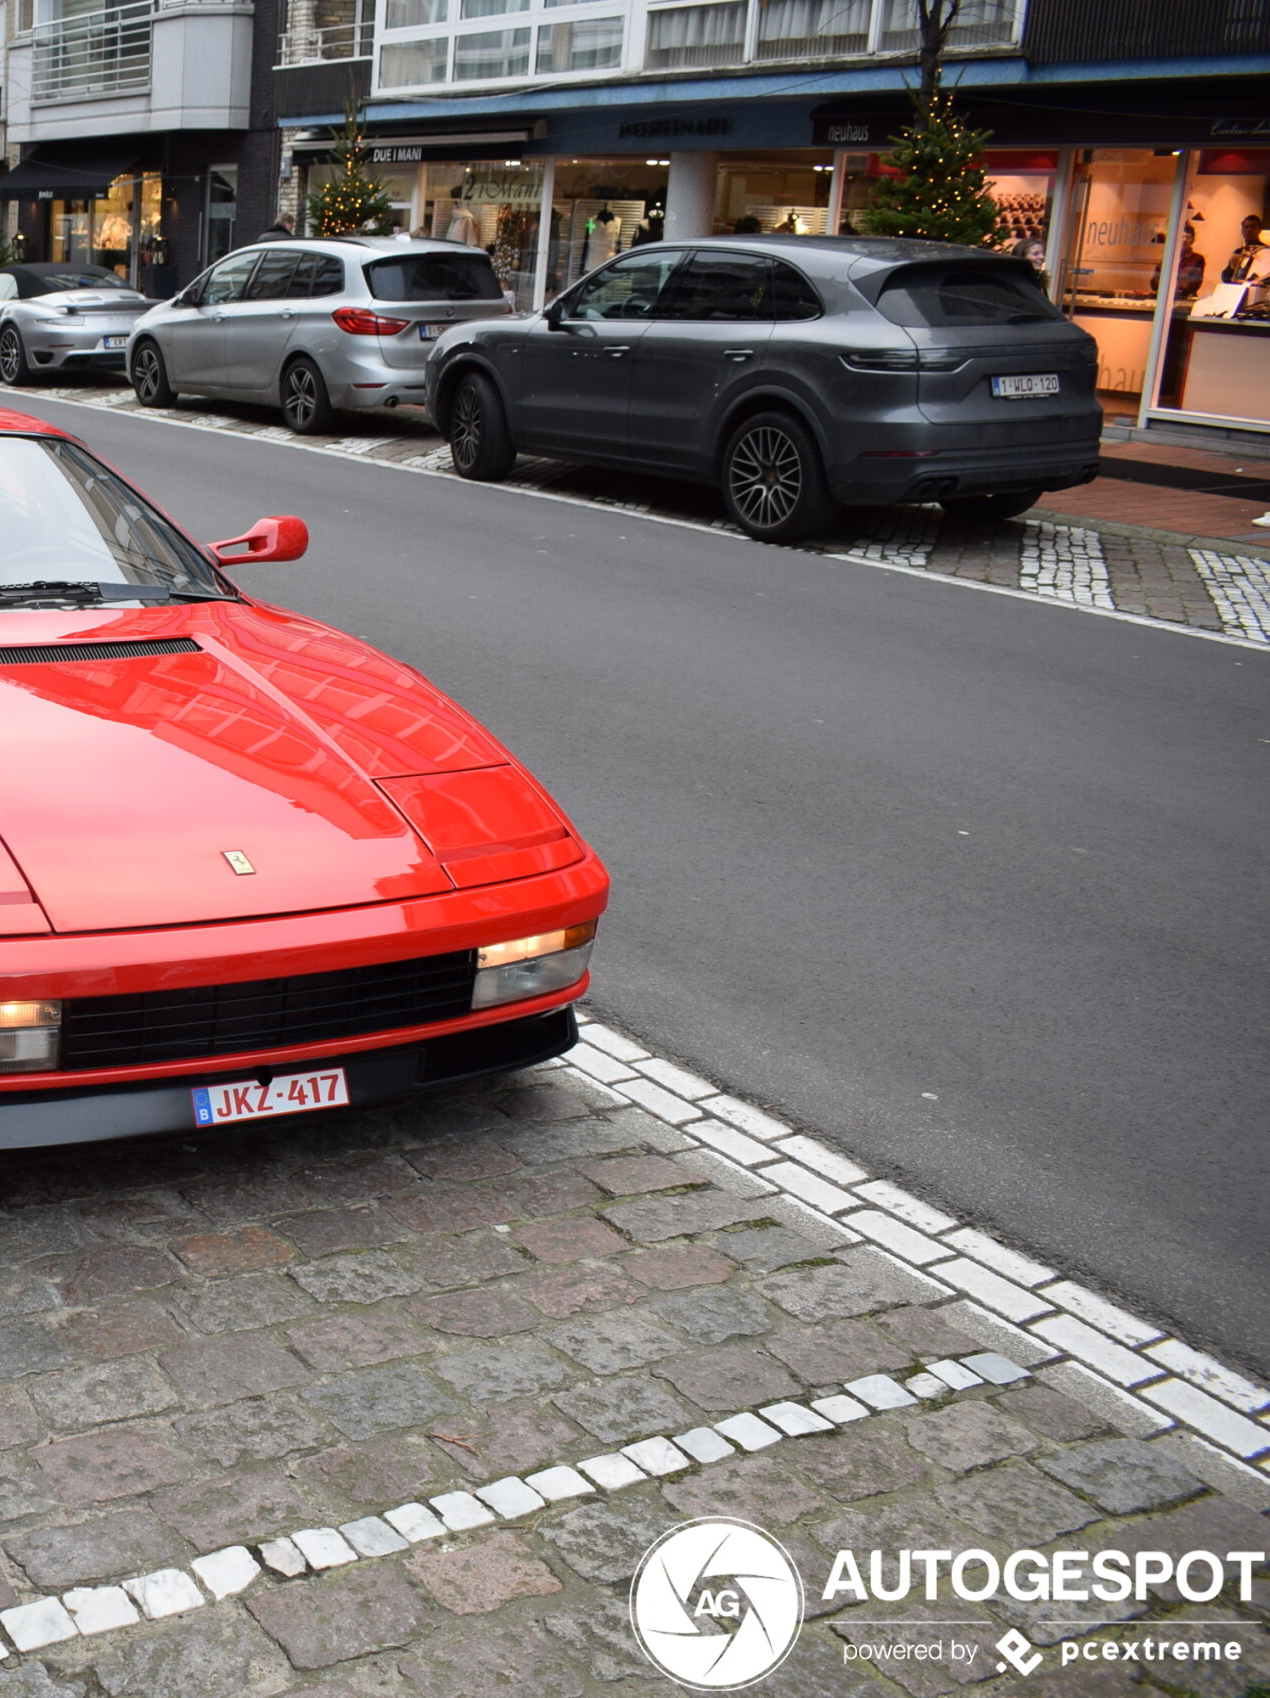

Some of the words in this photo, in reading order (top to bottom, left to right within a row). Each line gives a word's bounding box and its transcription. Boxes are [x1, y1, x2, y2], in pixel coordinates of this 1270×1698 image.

[828, 121, 870, 142] neuhaus
[373, 149, 392, 162] DUE
[397, 147, 422, 161] MANI
[1086, 214, 1160, 247] neuhaus
[200, 1109, 210, 1120] B
